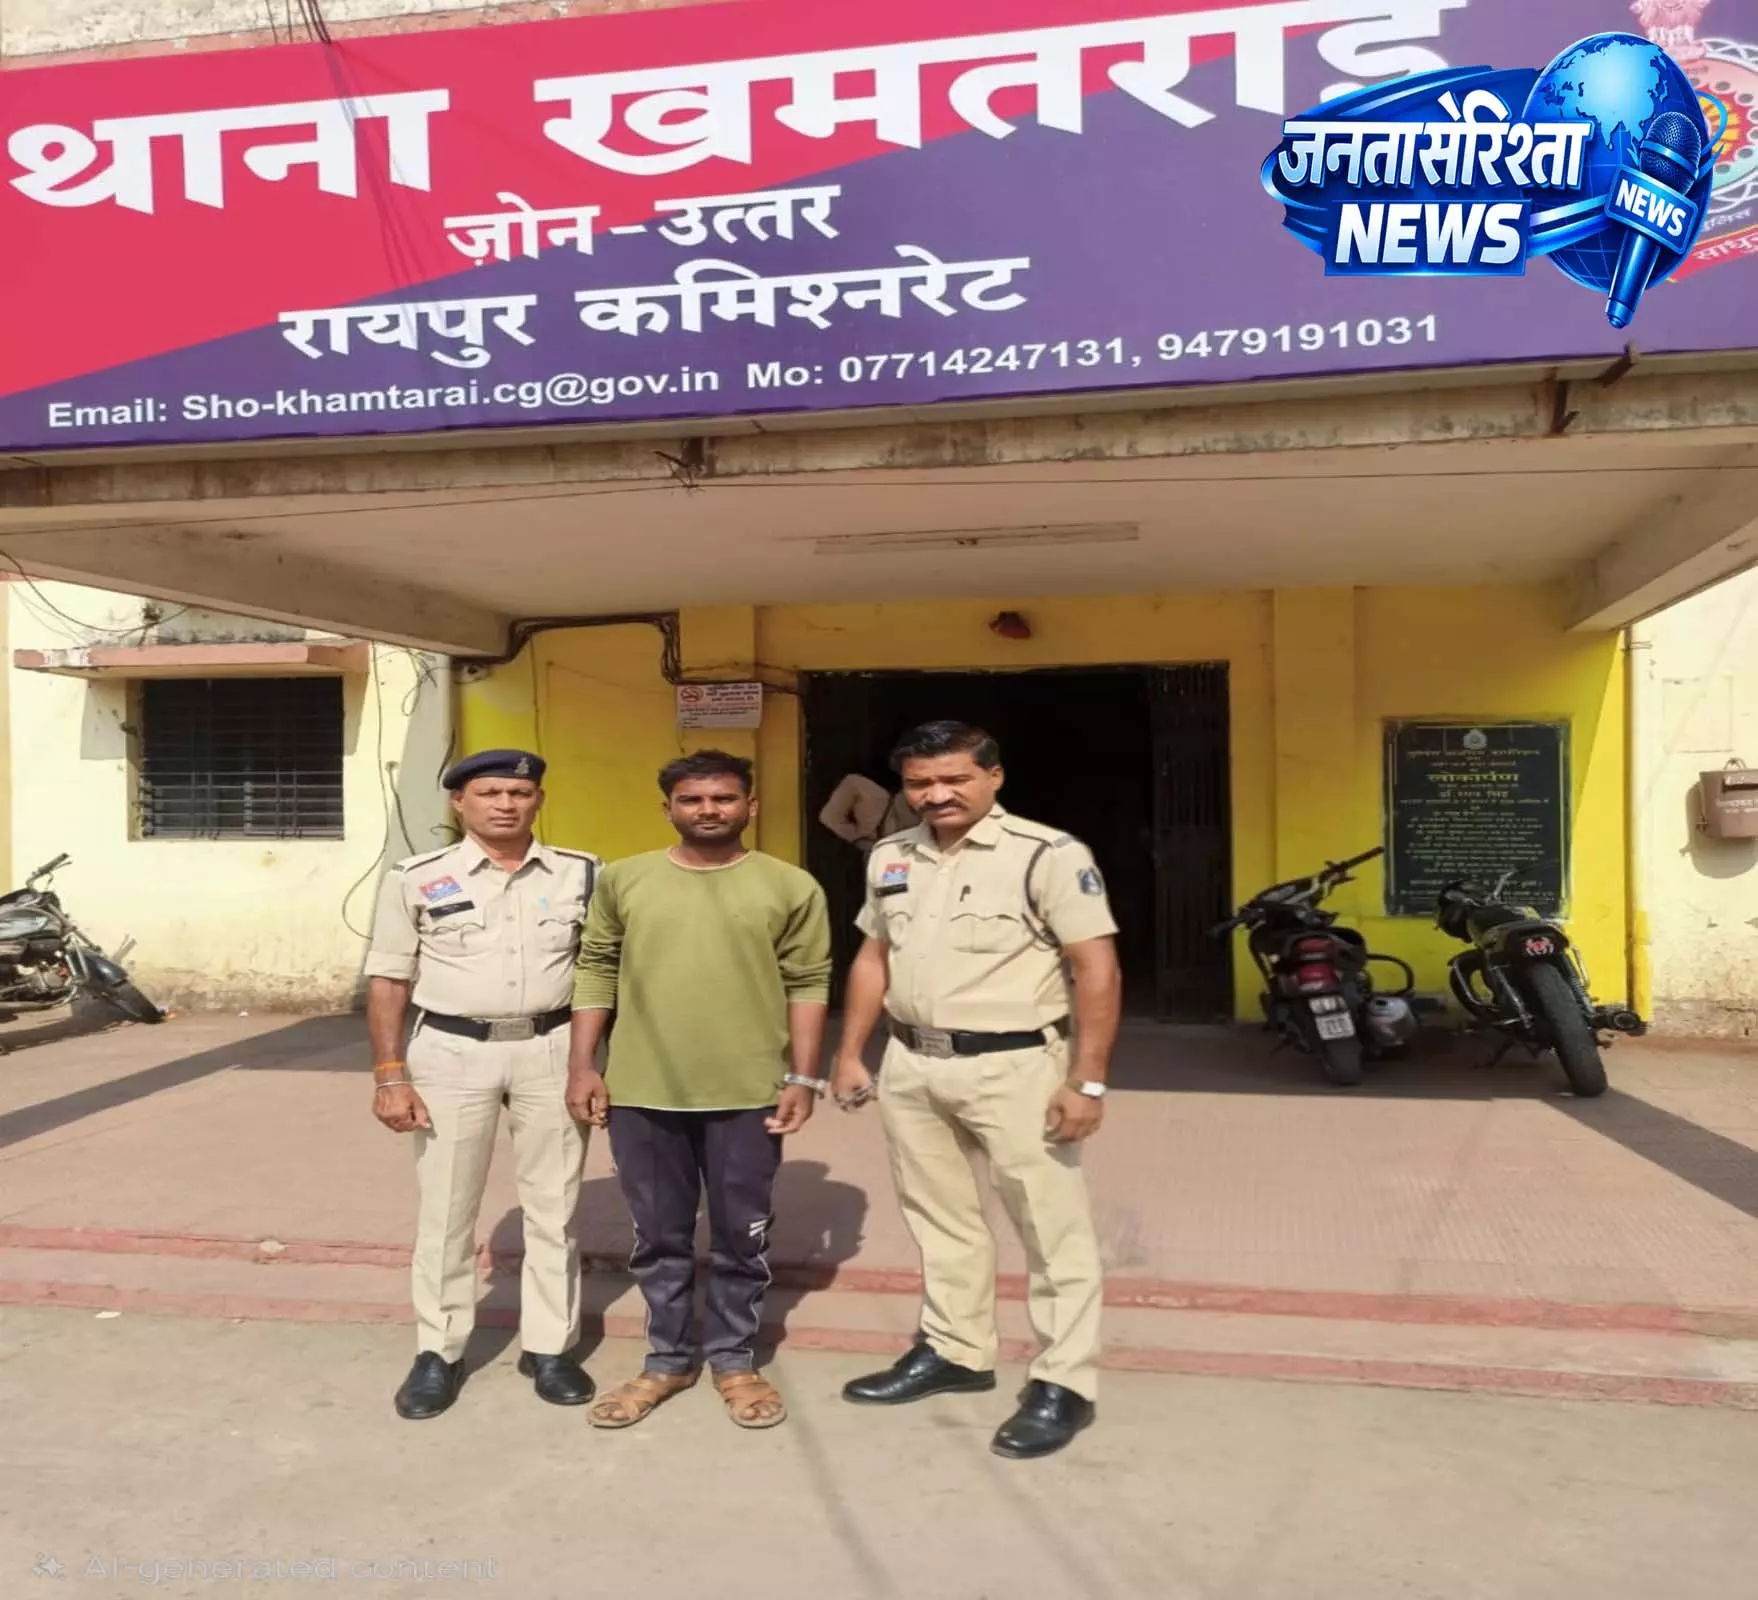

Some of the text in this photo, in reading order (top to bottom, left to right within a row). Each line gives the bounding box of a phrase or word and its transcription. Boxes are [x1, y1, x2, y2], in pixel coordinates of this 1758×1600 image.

[8, 89, 450, 214] थाना
[279, 245, 1030, 369] रायपुर कमिश्नरेट
[48, 314, 1437, 428] Email: Sho-khamtarai.cg@gov.in Mo: 07714247131, 9479191031
